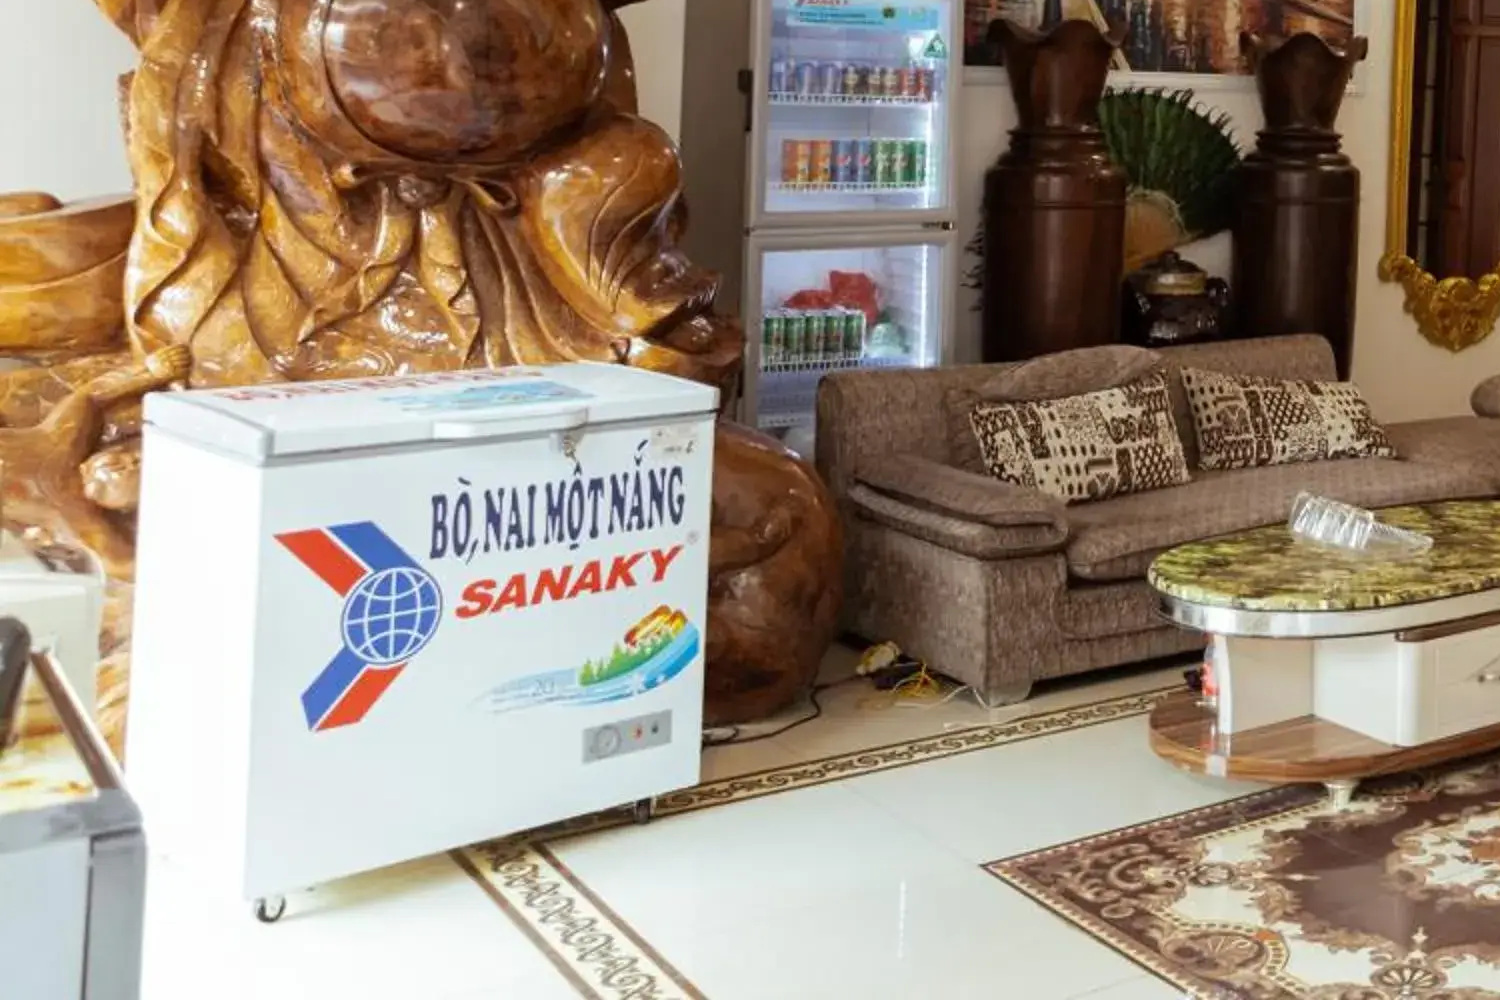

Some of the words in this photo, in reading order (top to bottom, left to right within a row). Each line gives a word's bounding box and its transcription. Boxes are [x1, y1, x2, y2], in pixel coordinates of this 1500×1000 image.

[483, 484, 538, 553] NAI
[543, 462, 605, 551] MỘT
[454, 544, 685, 620] SANAKY
